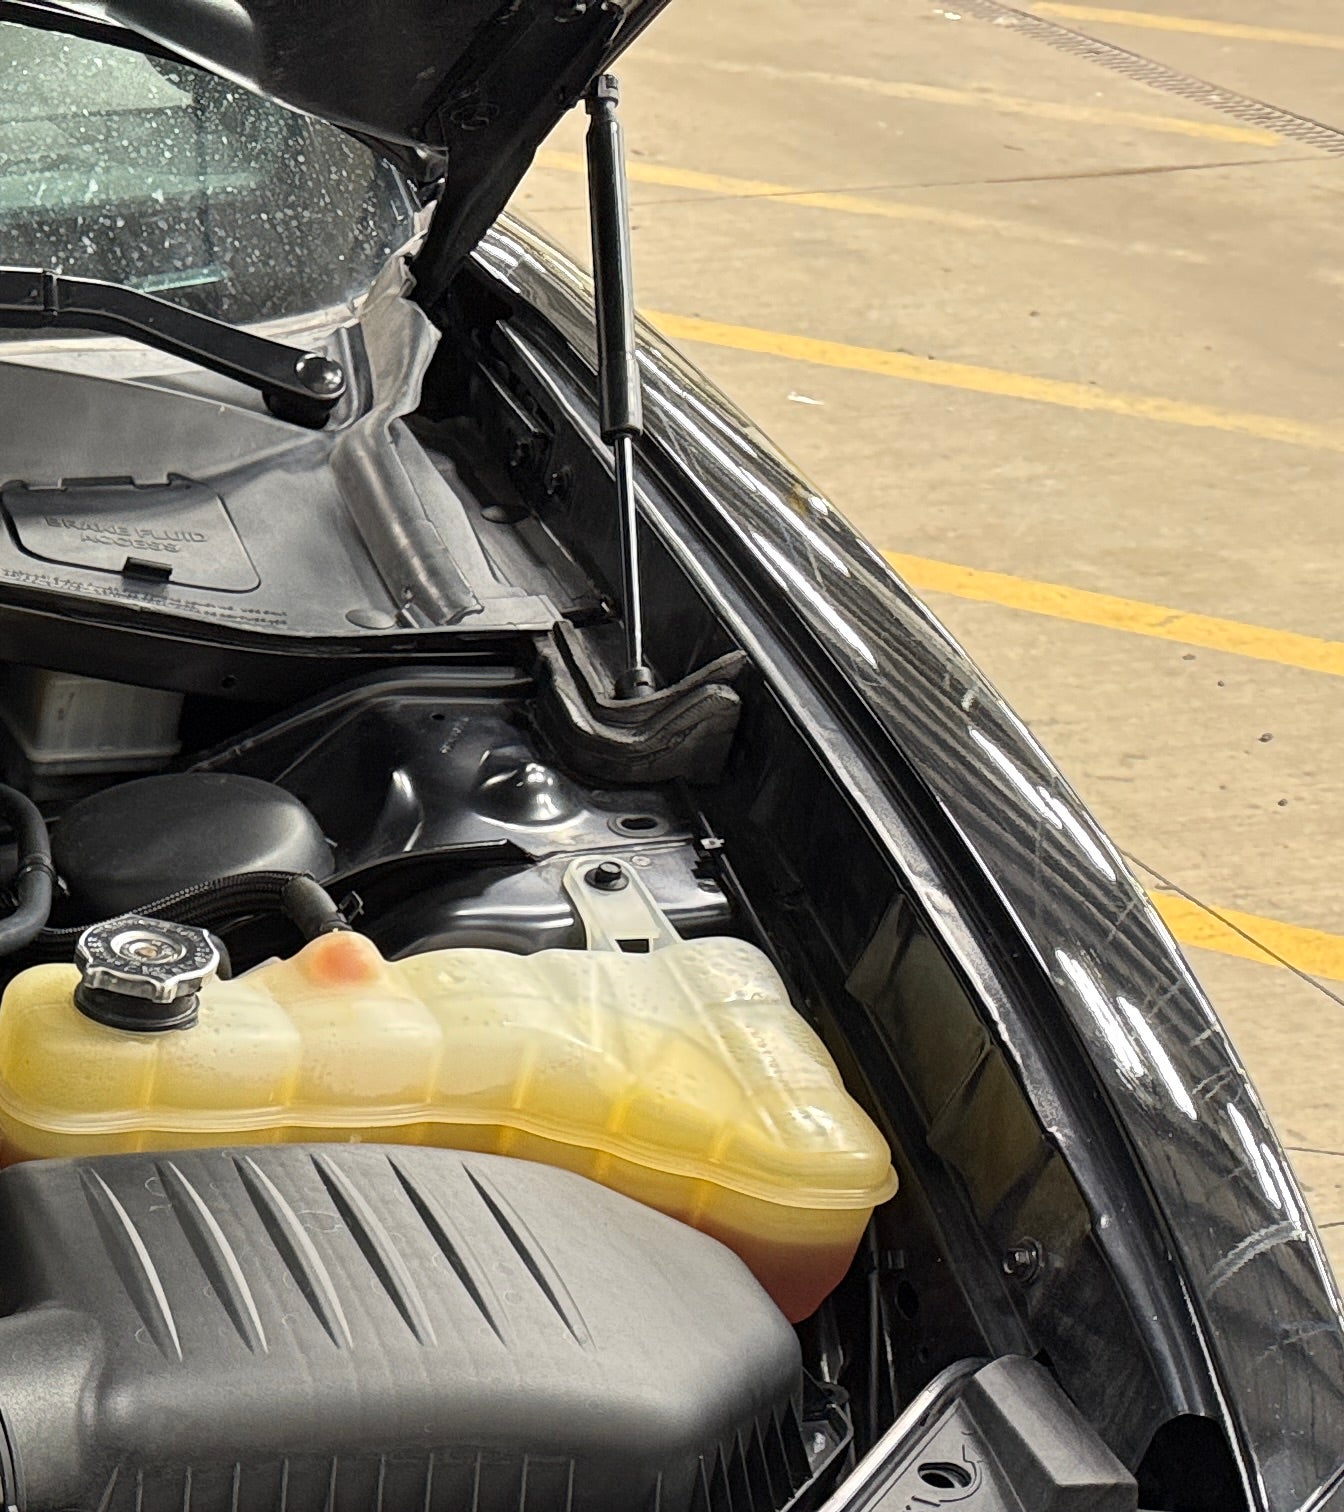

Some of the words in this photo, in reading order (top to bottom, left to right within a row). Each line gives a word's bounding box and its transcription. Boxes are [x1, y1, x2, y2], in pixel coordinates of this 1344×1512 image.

[43, 515, 129, 538] BRAKE
[135, 526, 208, 545] FLUID
[80, 532, 180, 553] ACCESS
